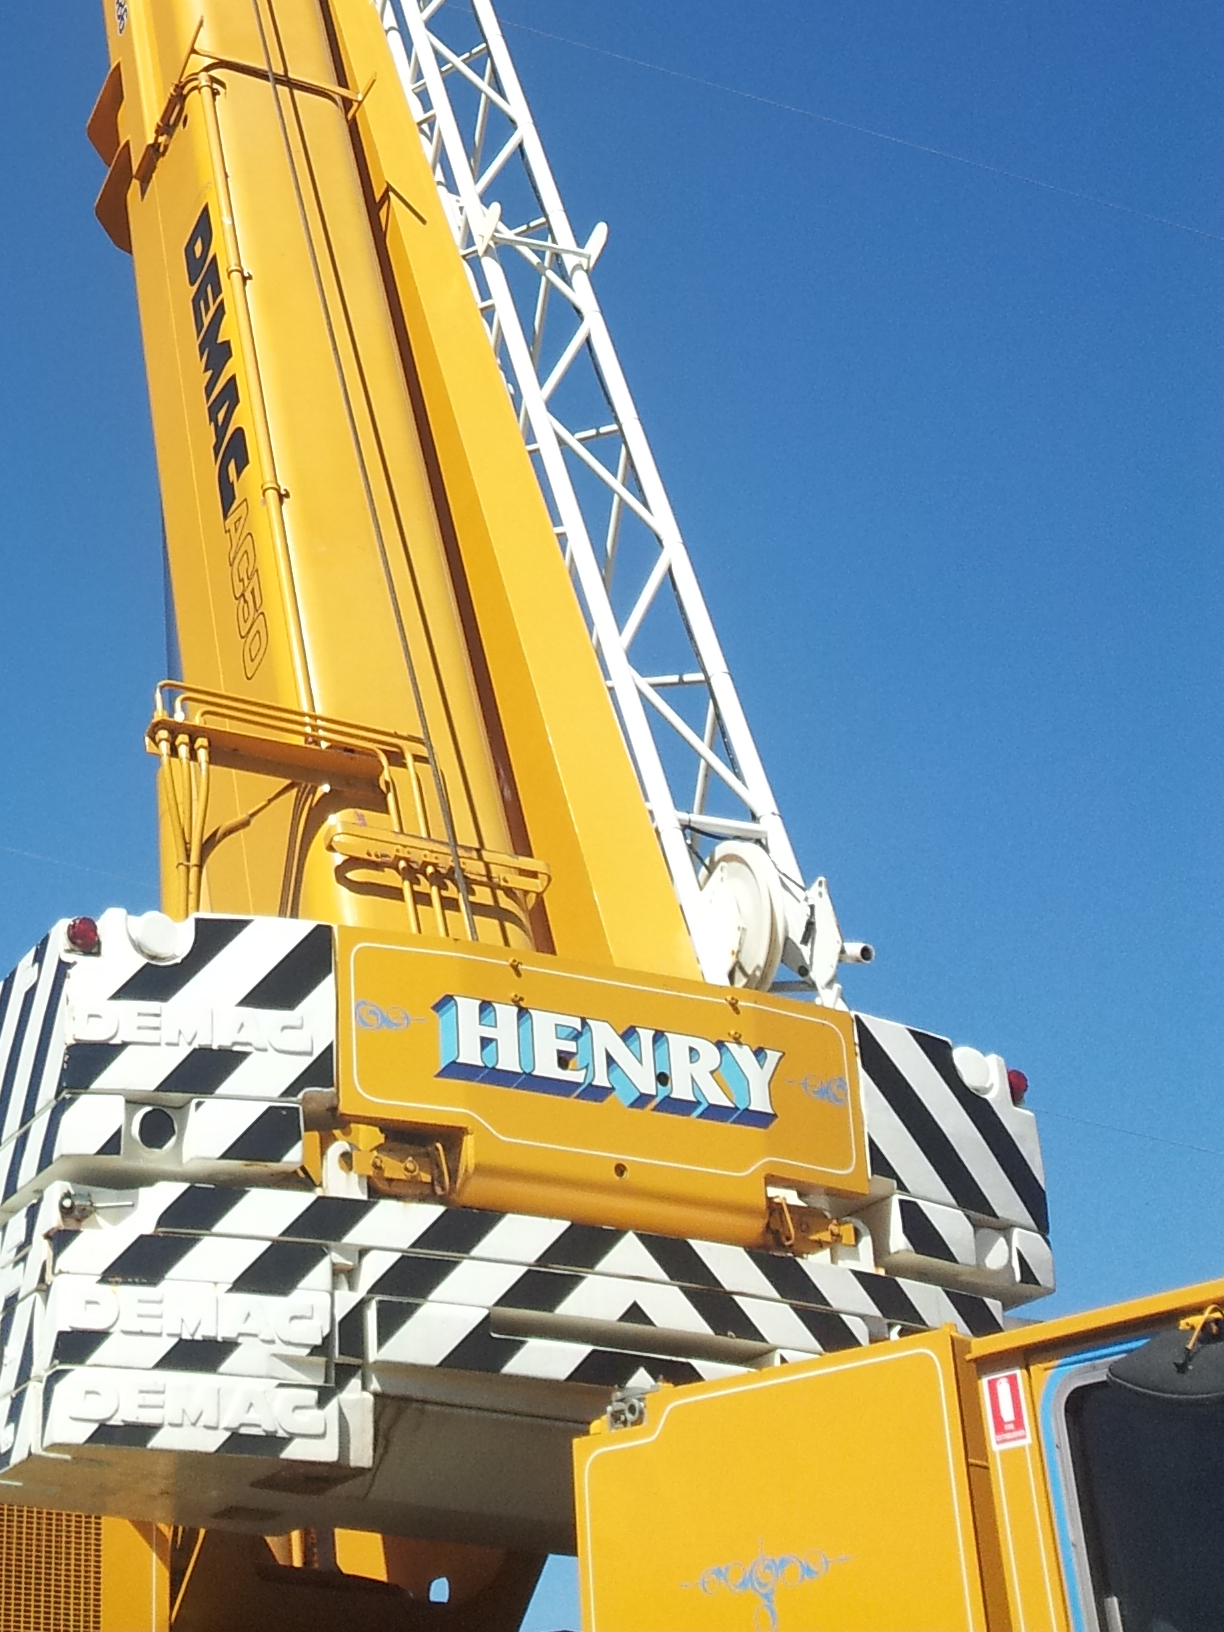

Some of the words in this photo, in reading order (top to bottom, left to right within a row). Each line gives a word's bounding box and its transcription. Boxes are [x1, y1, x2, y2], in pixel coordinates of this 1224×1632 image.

[72, 1002, 315, 1057] DEMAG
[431, 993, 786, 1130] HENRY
[69, 1290, 325, 1349] DEMAG
[69, 1379, 328, 1439] DEMAG
